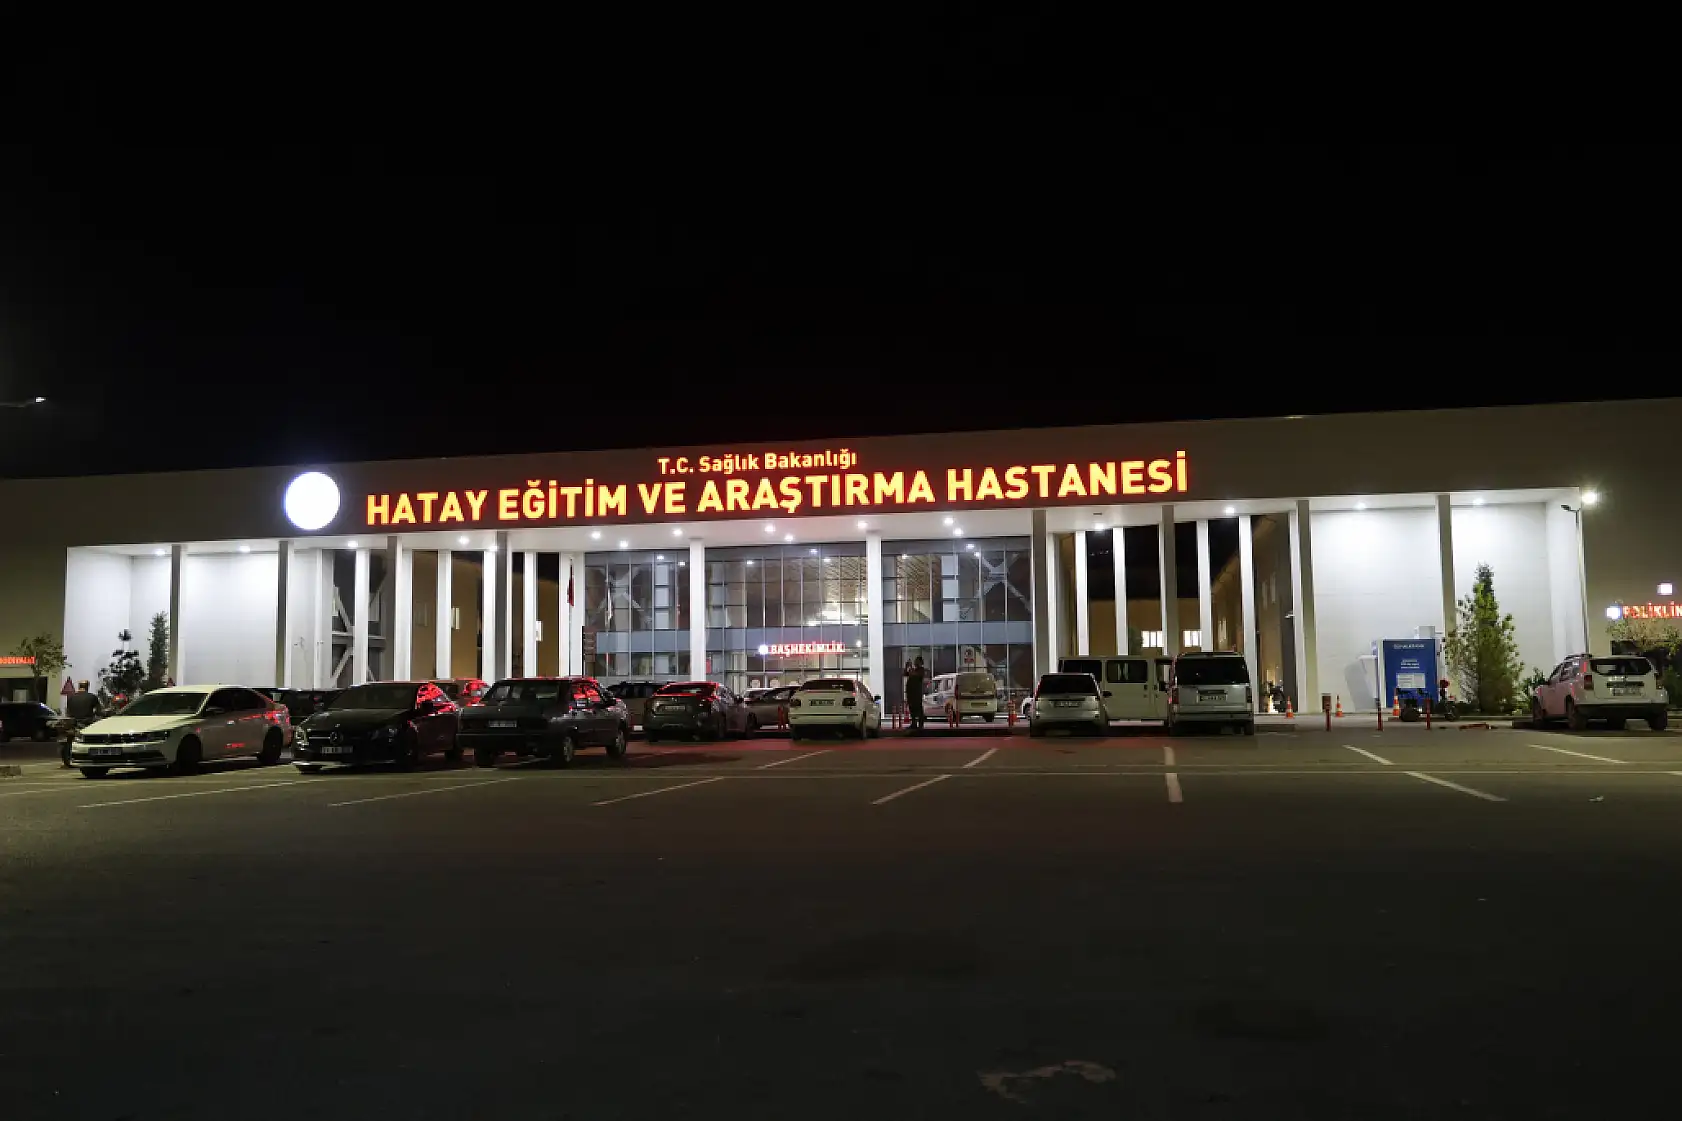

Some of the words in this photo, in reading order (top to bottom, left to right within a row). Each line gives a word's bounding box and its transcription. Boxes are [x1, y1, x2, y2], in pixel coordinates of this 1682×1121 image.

[657, 456, 694, 475] T.C.
[698, 453, 761, 475] Sağlık
[764, 448, 857, 470] Bakanlığı
[367, 489, 488, 526] HATAY
[498, 478, 627, 521] EĞİTİM
[636, 481, 686, 514] VE
[695, 470, 939, 517] ARAŞTIRMA
[947, 450, 1188, 503] HASTANESİ
[771, 640, 845, 657] BAŞHEKİMLİK
